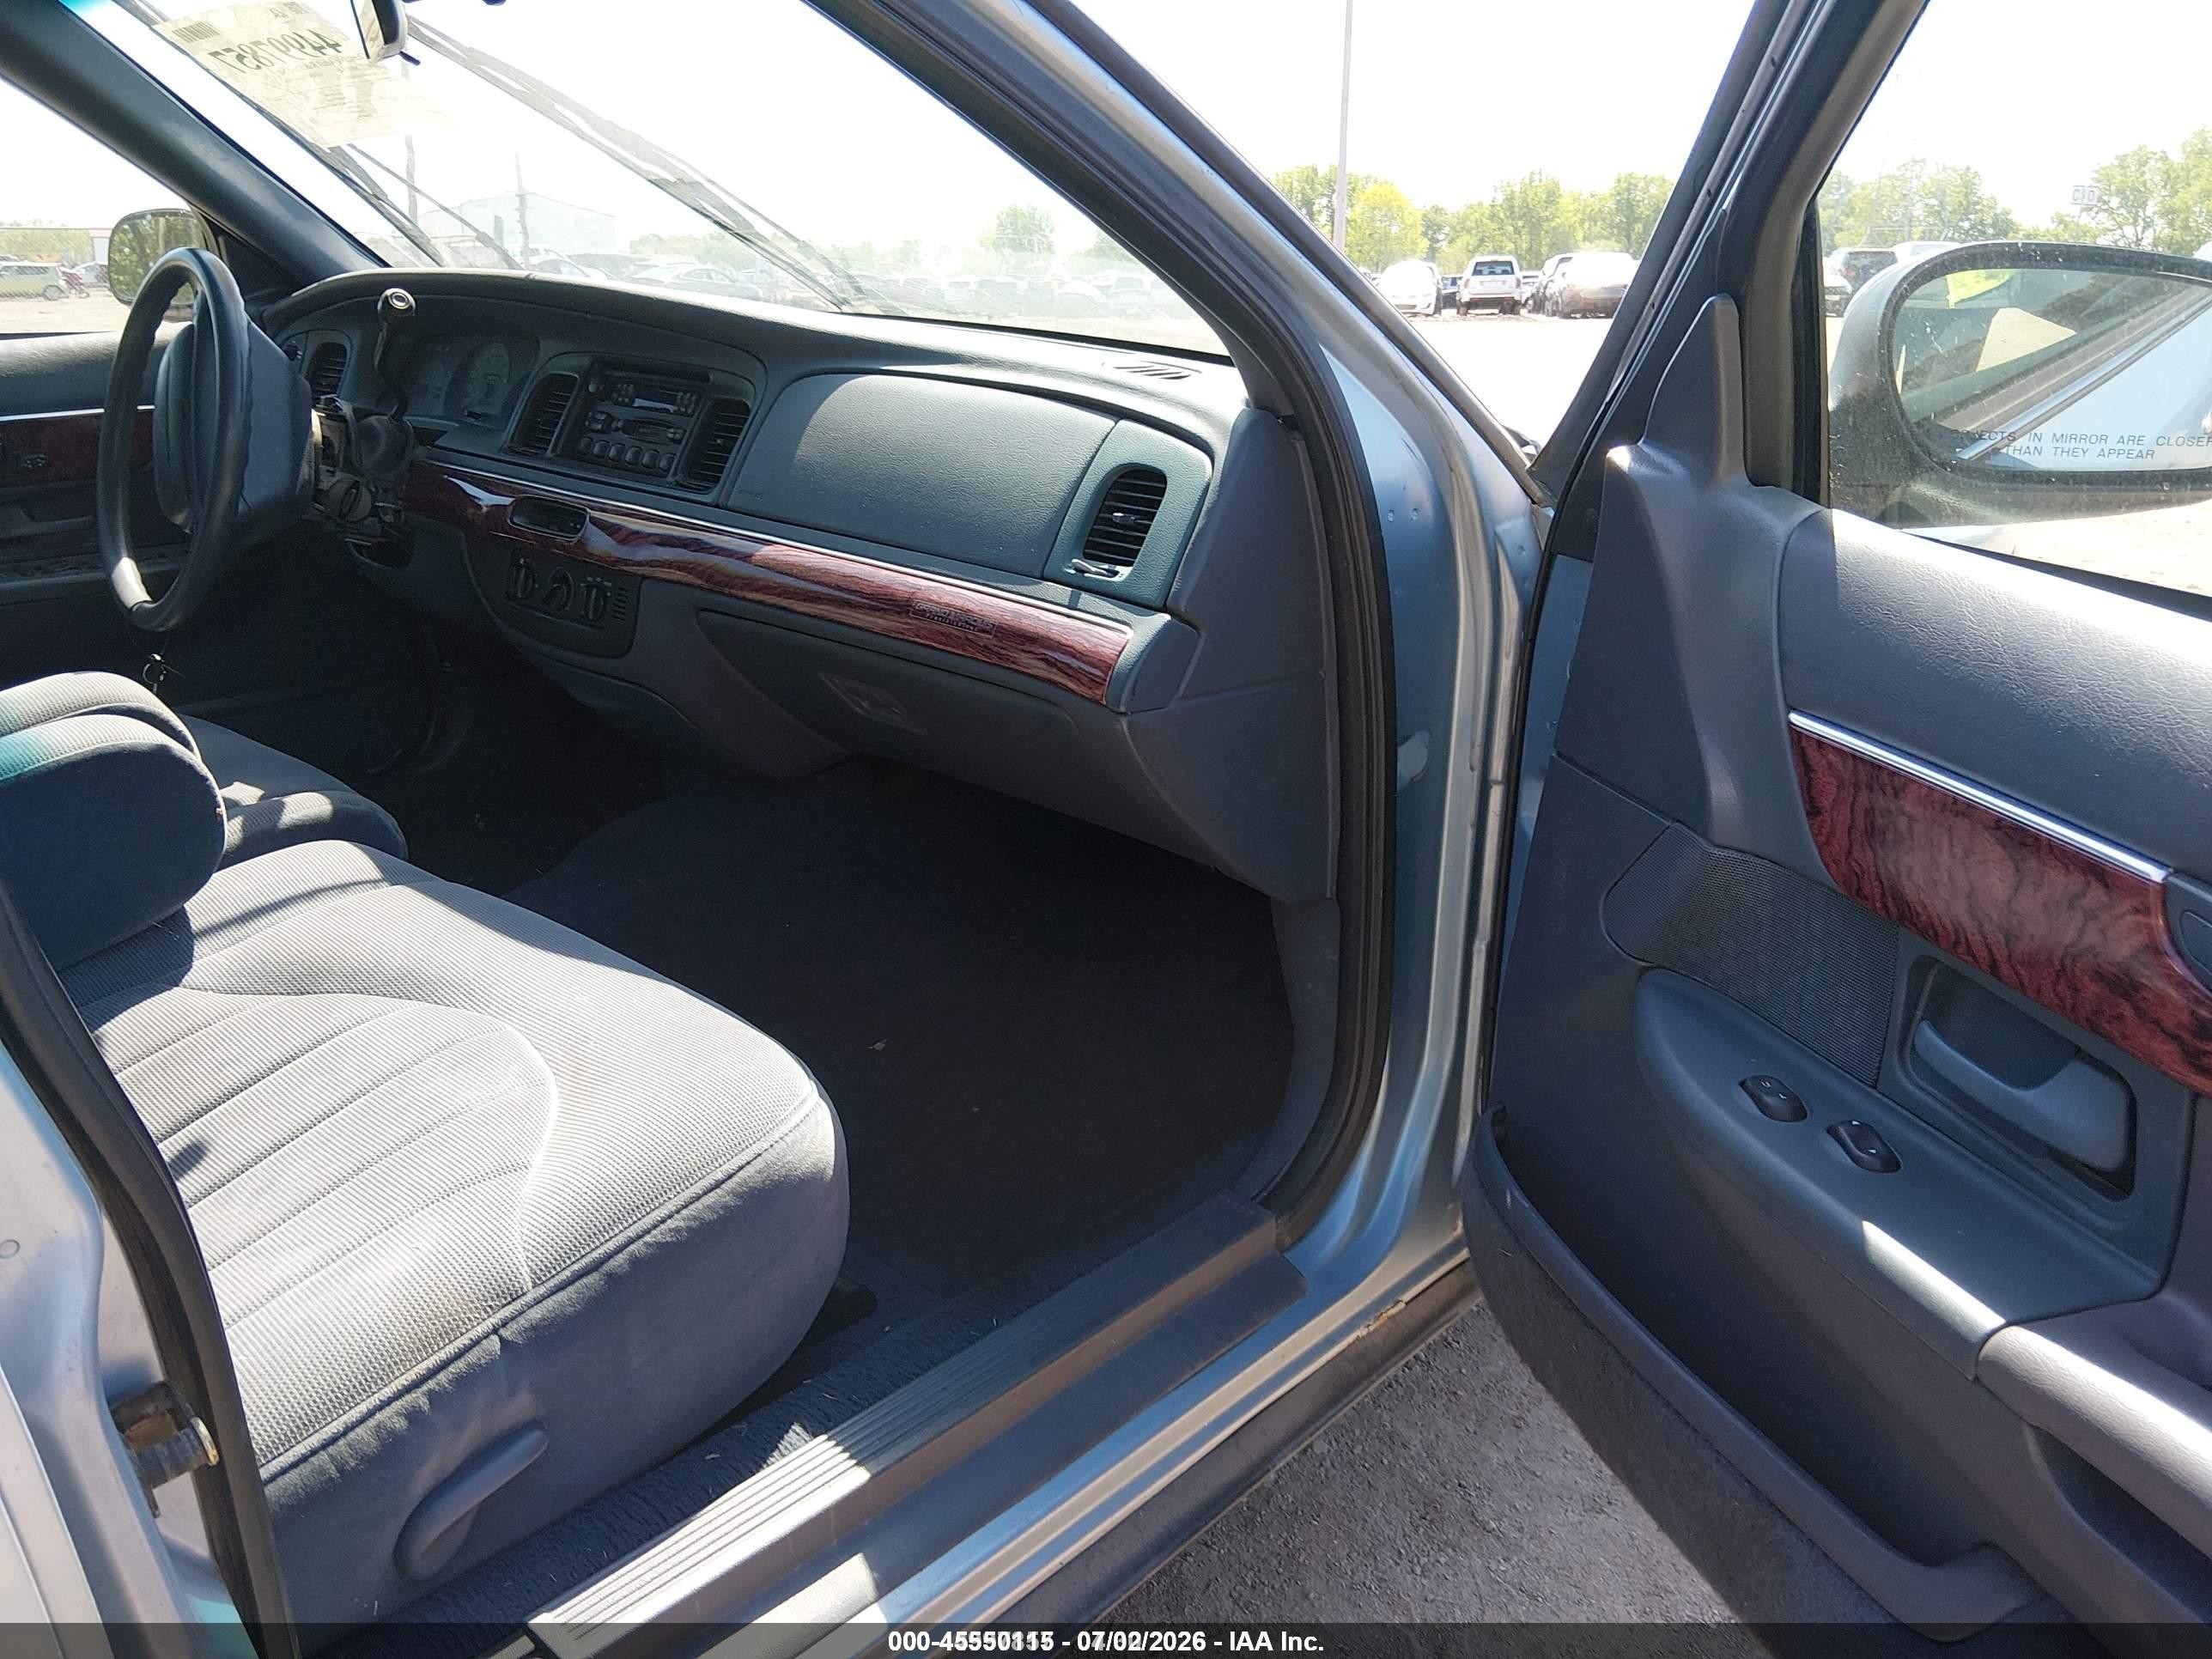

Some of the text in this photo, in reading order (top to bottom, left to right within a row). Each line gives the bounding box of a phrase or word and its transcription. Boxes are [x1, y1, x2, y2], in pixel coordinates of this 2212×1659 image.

[1951, 429, 2017, 442] JECTS
[2028, 432, 2043, 442] IN
[2051, 434, 2108, 445] MIRROR
[2115, 435, 2146, 446] ARE
[2005, 446, 2155, 459] THAN THEY APPEAR
